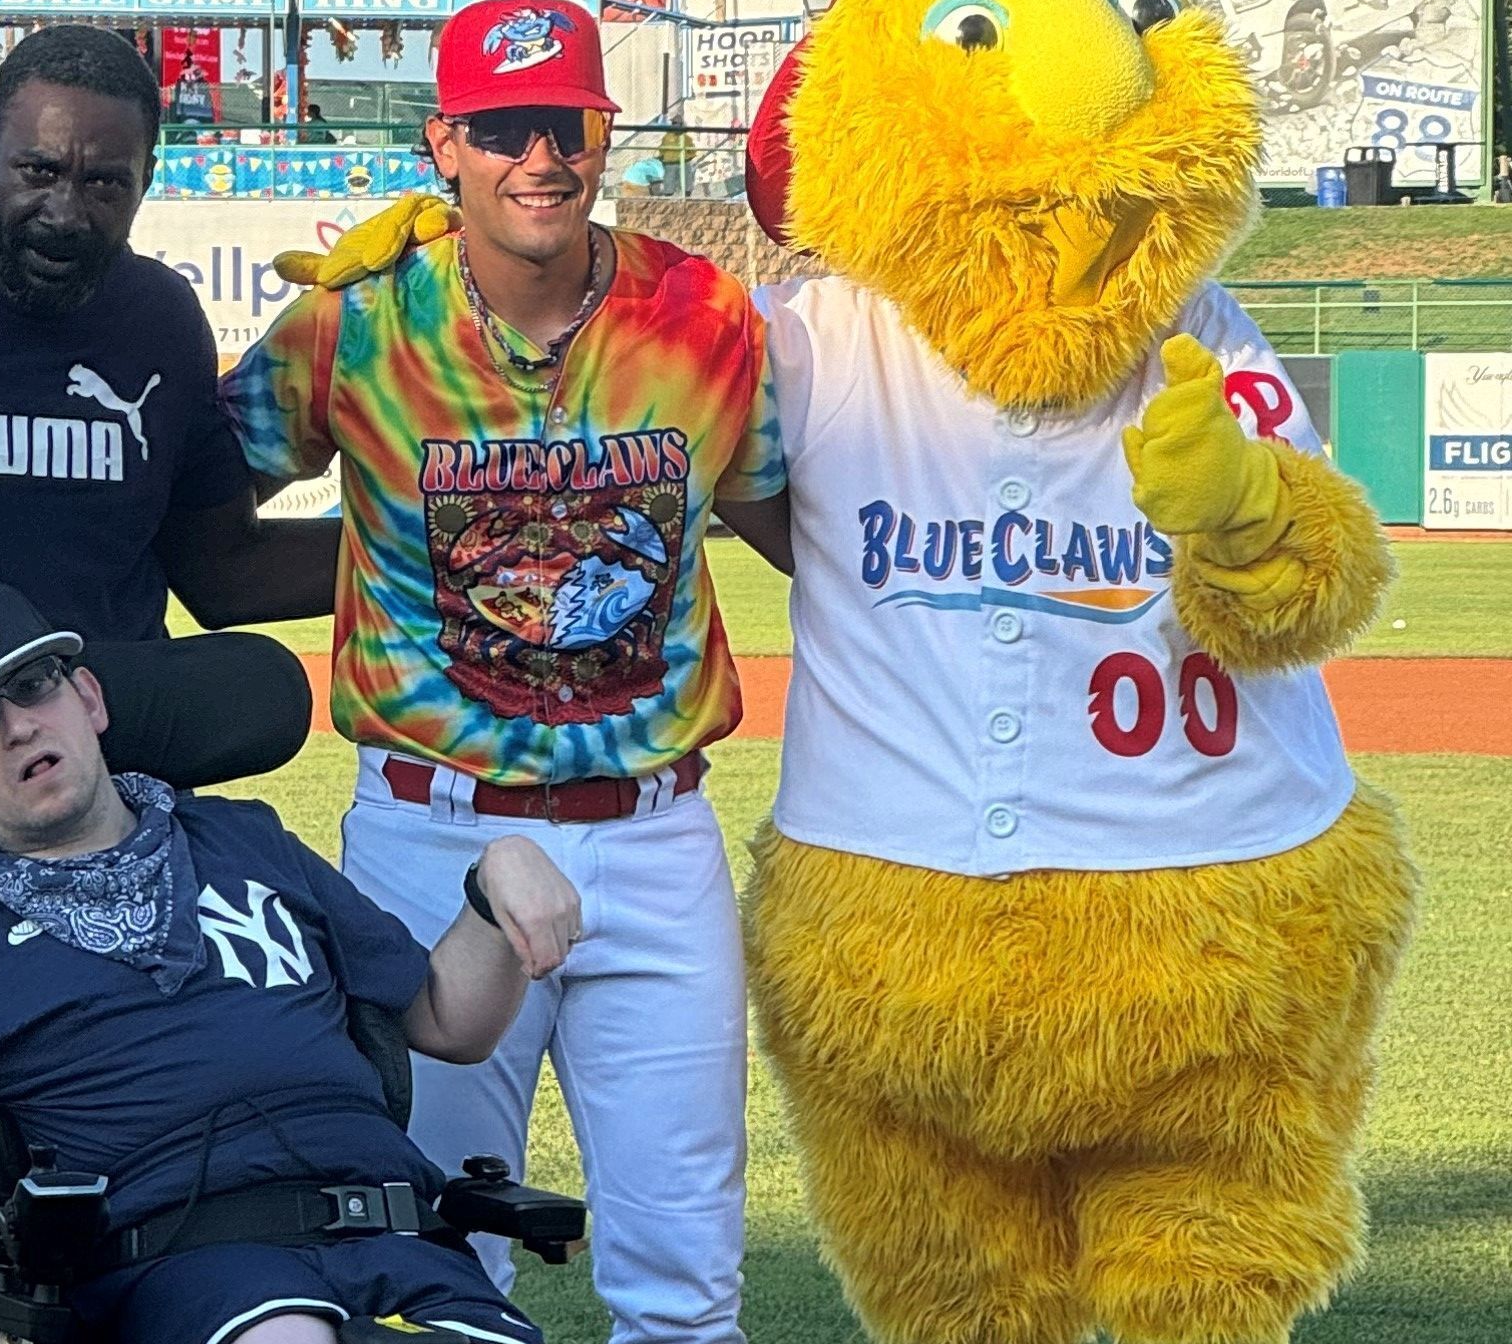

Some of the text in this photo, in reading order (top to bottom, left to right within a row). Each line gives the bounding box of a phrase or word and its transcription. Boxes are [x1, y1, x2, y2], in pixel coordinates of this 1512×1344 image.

[1375, 81, 1465, 106] ON ROUTE
[420, 429, 690, 494] BLUECLAWS
[1444, 441, 1512, 465] FLIG
[1429, 487, 1496, 518] 2.6g CARBS
[1087, 651, 1239, 758] 00
[198, 879, 315, 989] NY
